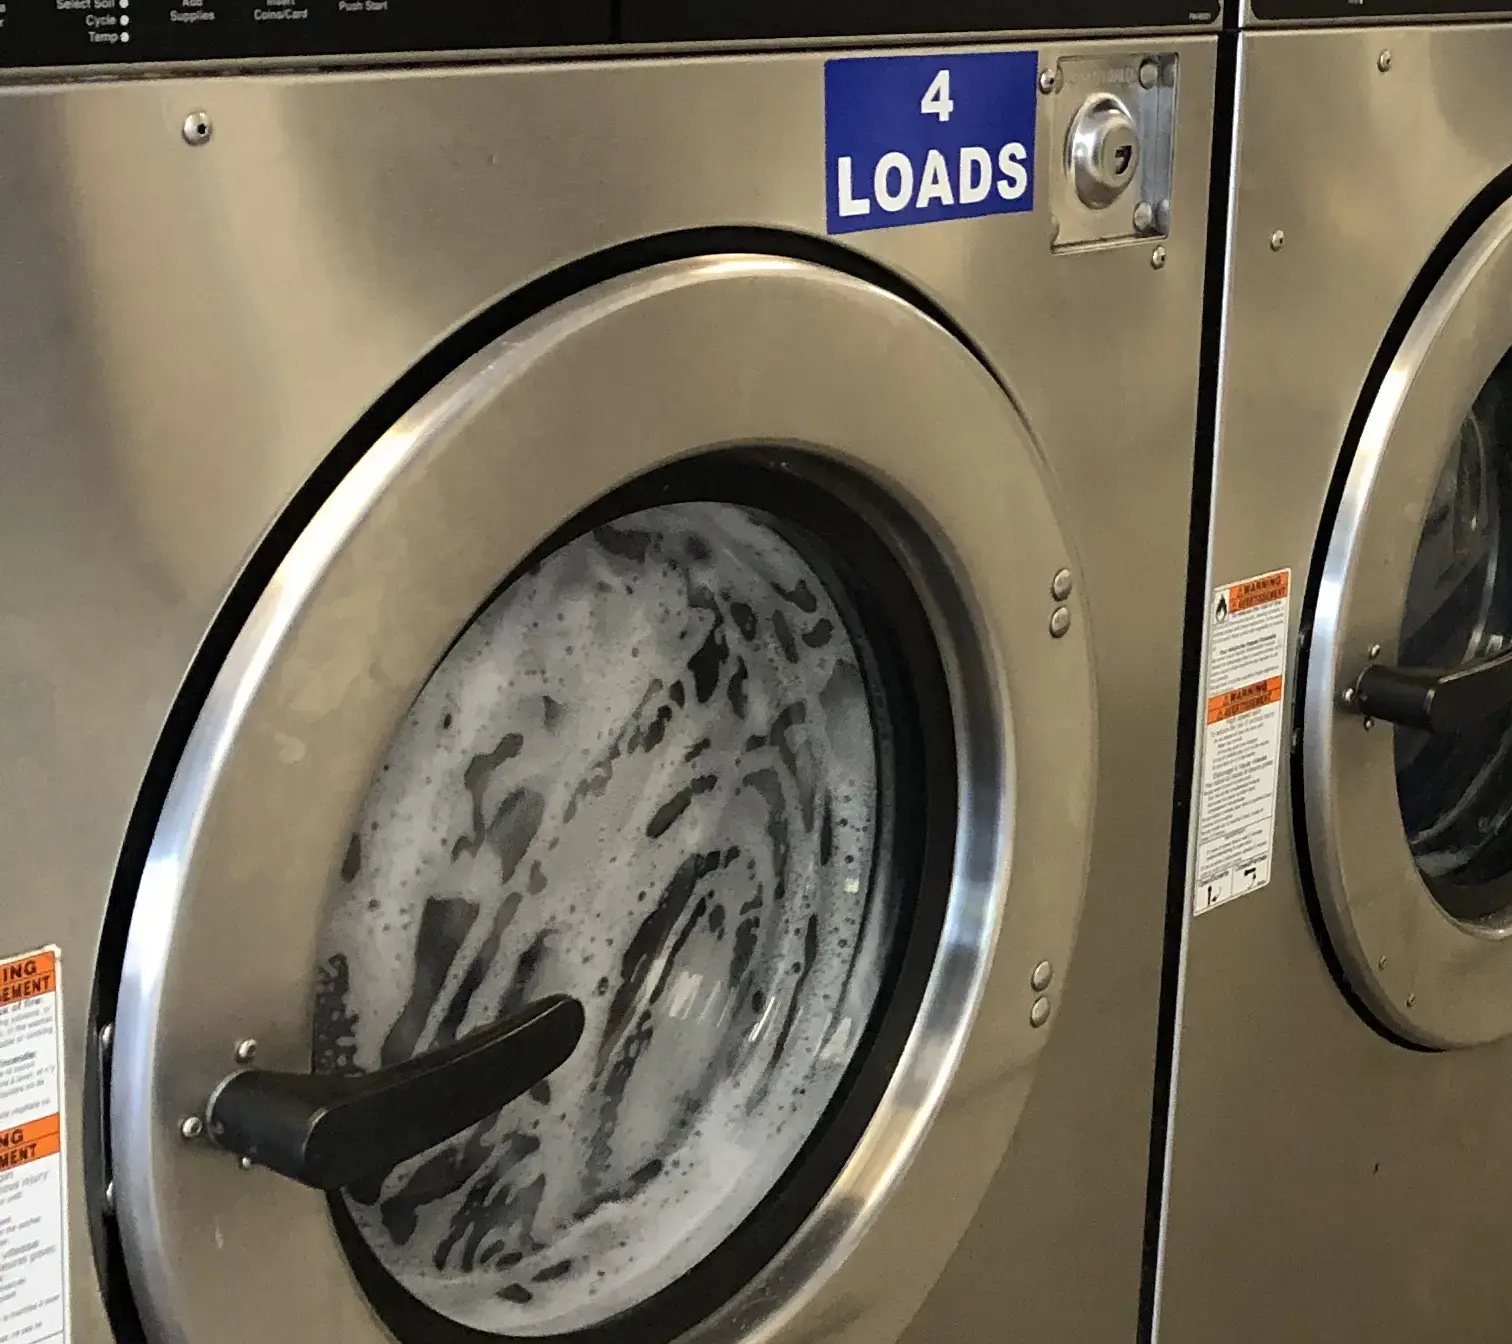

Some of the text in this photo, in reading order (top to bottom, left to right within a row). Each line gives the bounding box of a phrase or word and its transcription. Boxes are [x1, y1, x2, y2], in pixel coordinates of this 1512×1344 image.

[339, 0, 388, 11] Push Start
[85, 14, 117, 27] Cycle
[170, 10, 215, 22] Supplies
[88, 31, 119, 44] Temp
[920, 70, 954, 122] 4
[837, 142, 1029, 217] LOADS
[1244, 576, 1281, 594] WARNING
[1230, 680, 1268, 701] WARNING
